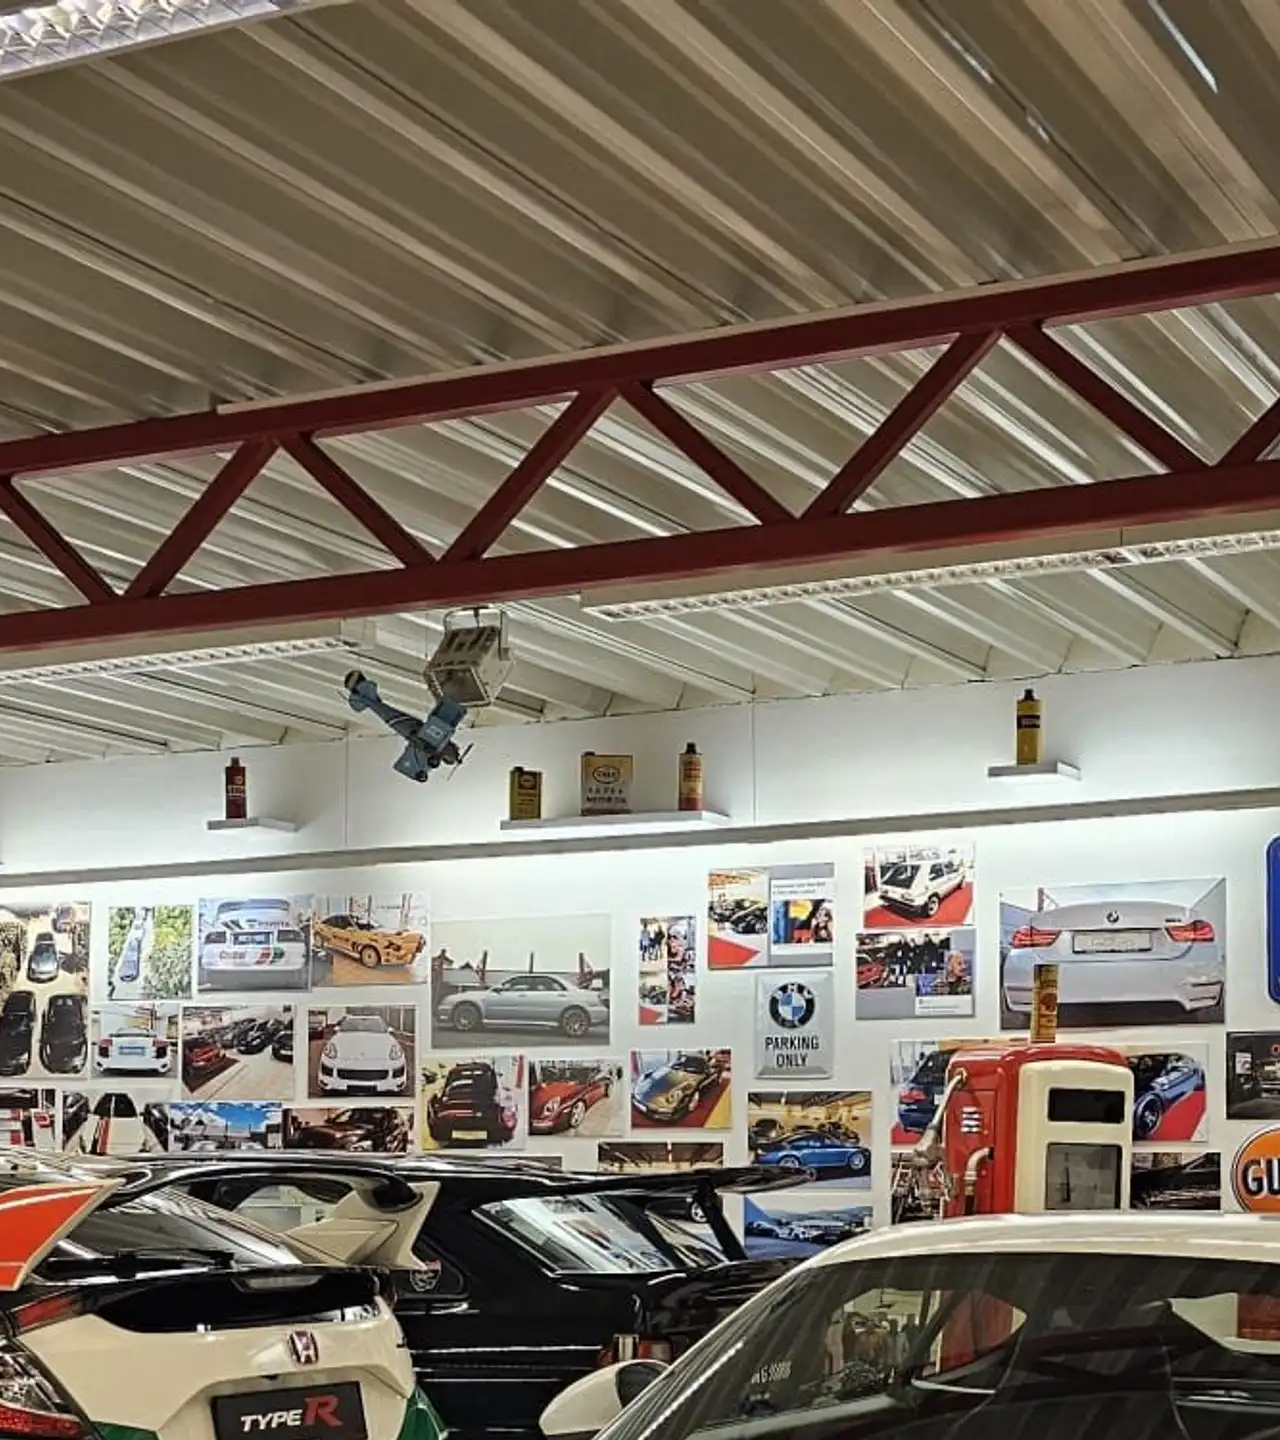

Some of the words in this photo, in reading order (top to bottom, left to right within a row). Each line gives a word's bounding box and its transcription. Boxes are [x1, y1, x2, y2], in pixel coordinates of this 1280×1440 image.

[765, 1035, 819, 1050] PARKING
[776, 1053, 808, 1068] ONLY
[241, 1409, 303, 1432] TYPE
[303, 1395, 343, 1428] R
